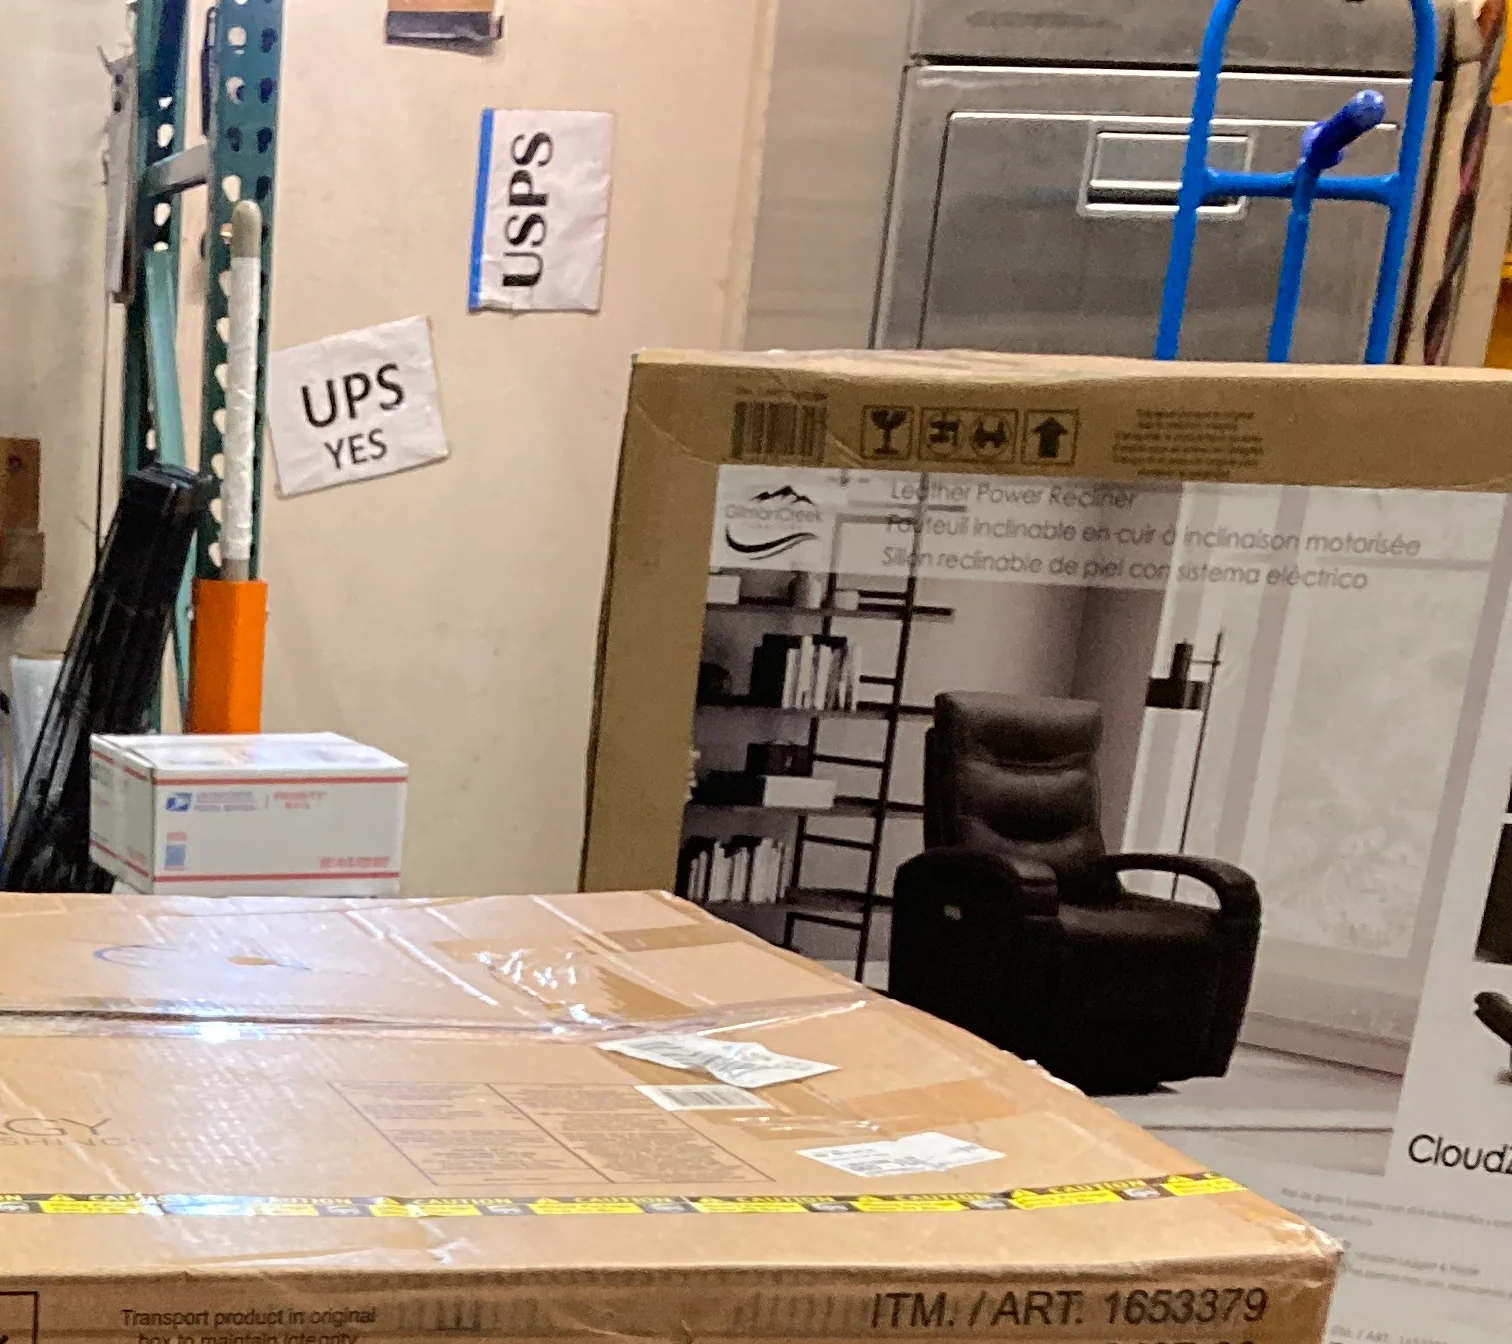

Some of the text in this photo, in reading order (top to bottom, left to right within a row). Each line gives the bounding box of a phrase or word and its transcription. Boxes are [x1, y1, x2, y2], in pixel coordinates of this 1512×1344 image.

[502, 131, 554, 288] USPS
[301, 363, 404, 428] UPS
[324, 428, 387, 469] YES
[977, 482, 1042, 505] Power
[935, 550, 1042, 574] reclinable
[1048, 554, 1078, 576] de
[1083, 557, 1124, 580] piel
[1129, 562, 1170, 579] con
[1177, 563, 1259, 585] sistema
[121, 1307, 376, 1329] Transport product in original
[871, 1287, 1269, 1328] ITM. / ART. 1653379
